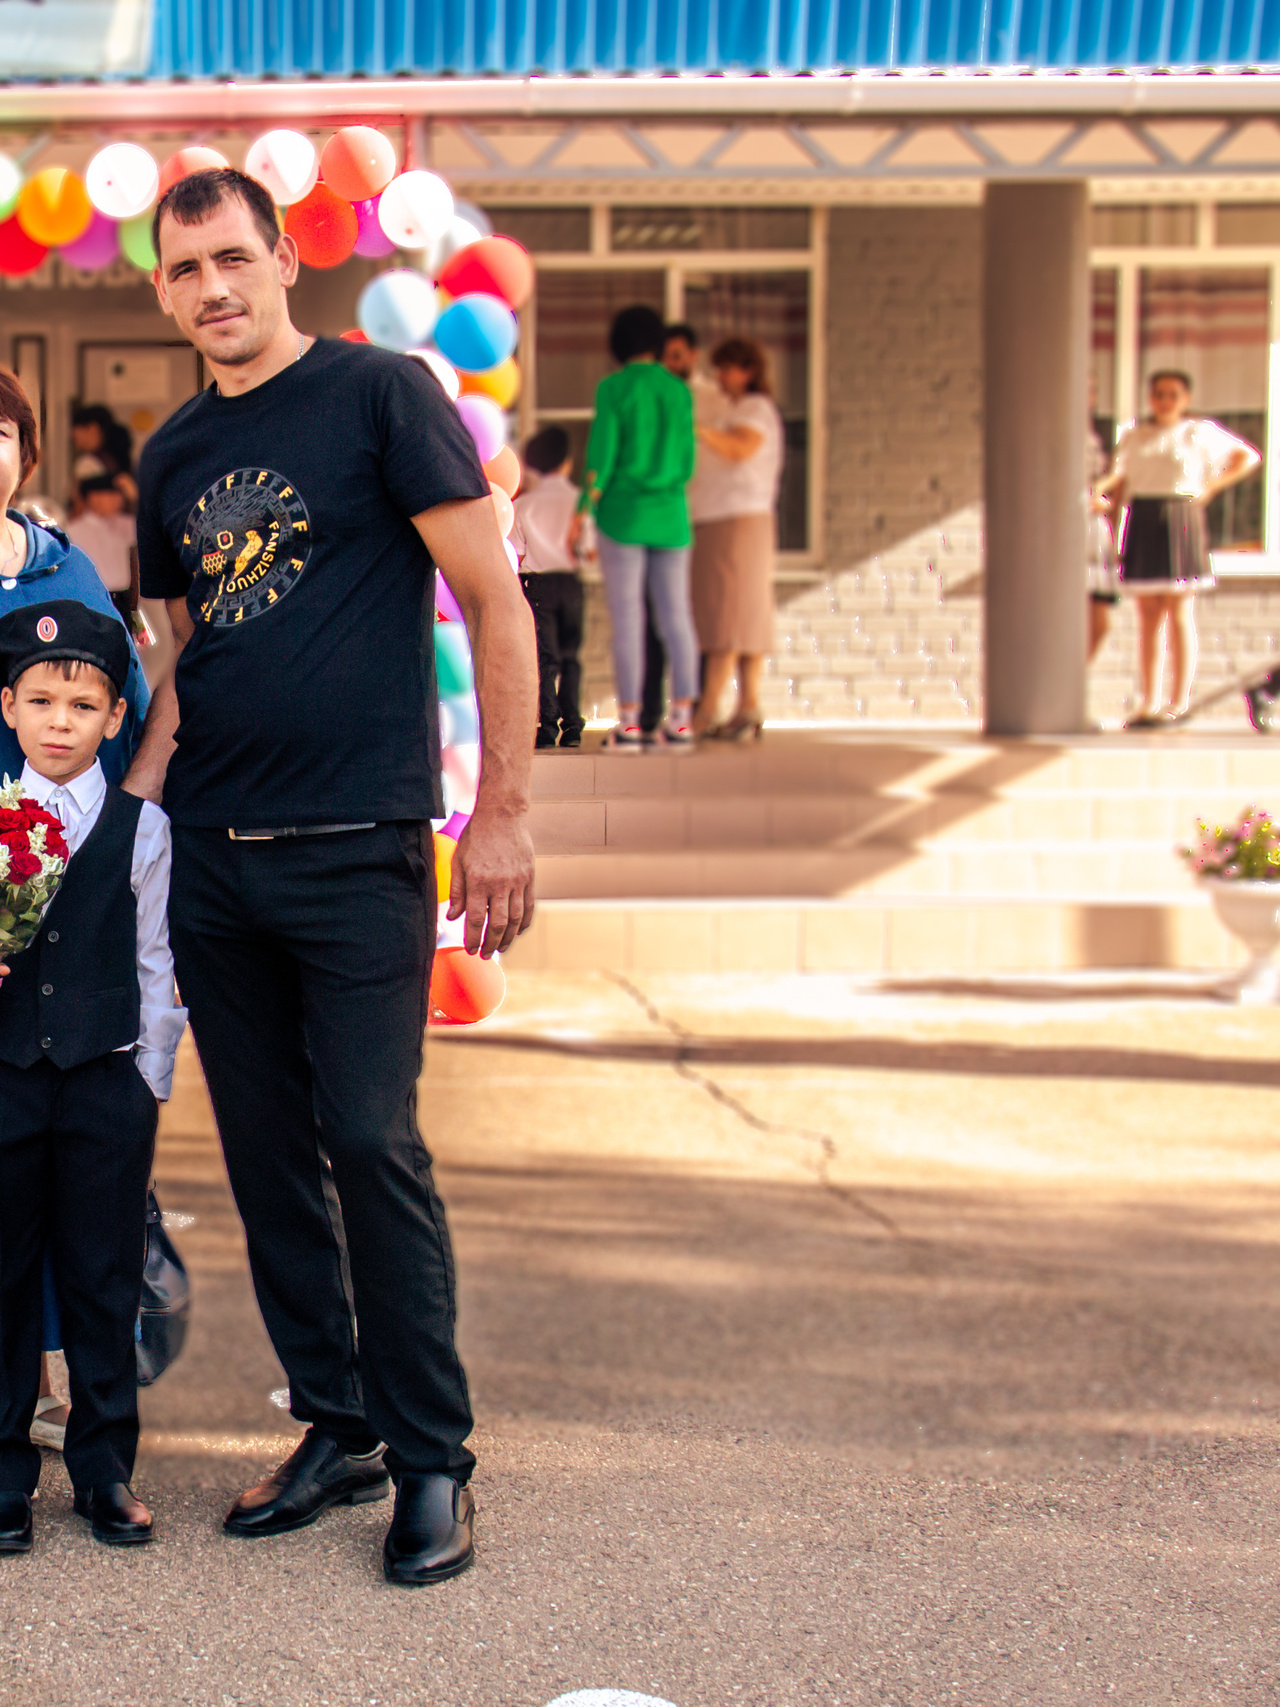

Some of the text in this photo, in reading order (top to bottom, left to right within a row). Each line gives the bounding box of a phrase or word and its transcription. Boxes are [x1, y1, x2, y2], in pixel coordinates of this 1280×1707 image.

[226, 473, 235, 489] F
[256, 471, 268, 485] F
[279, 486, 294, 499] F
[292, 520, 308, 532] F
[226, 520, 280, 593] FANSIZHUO
